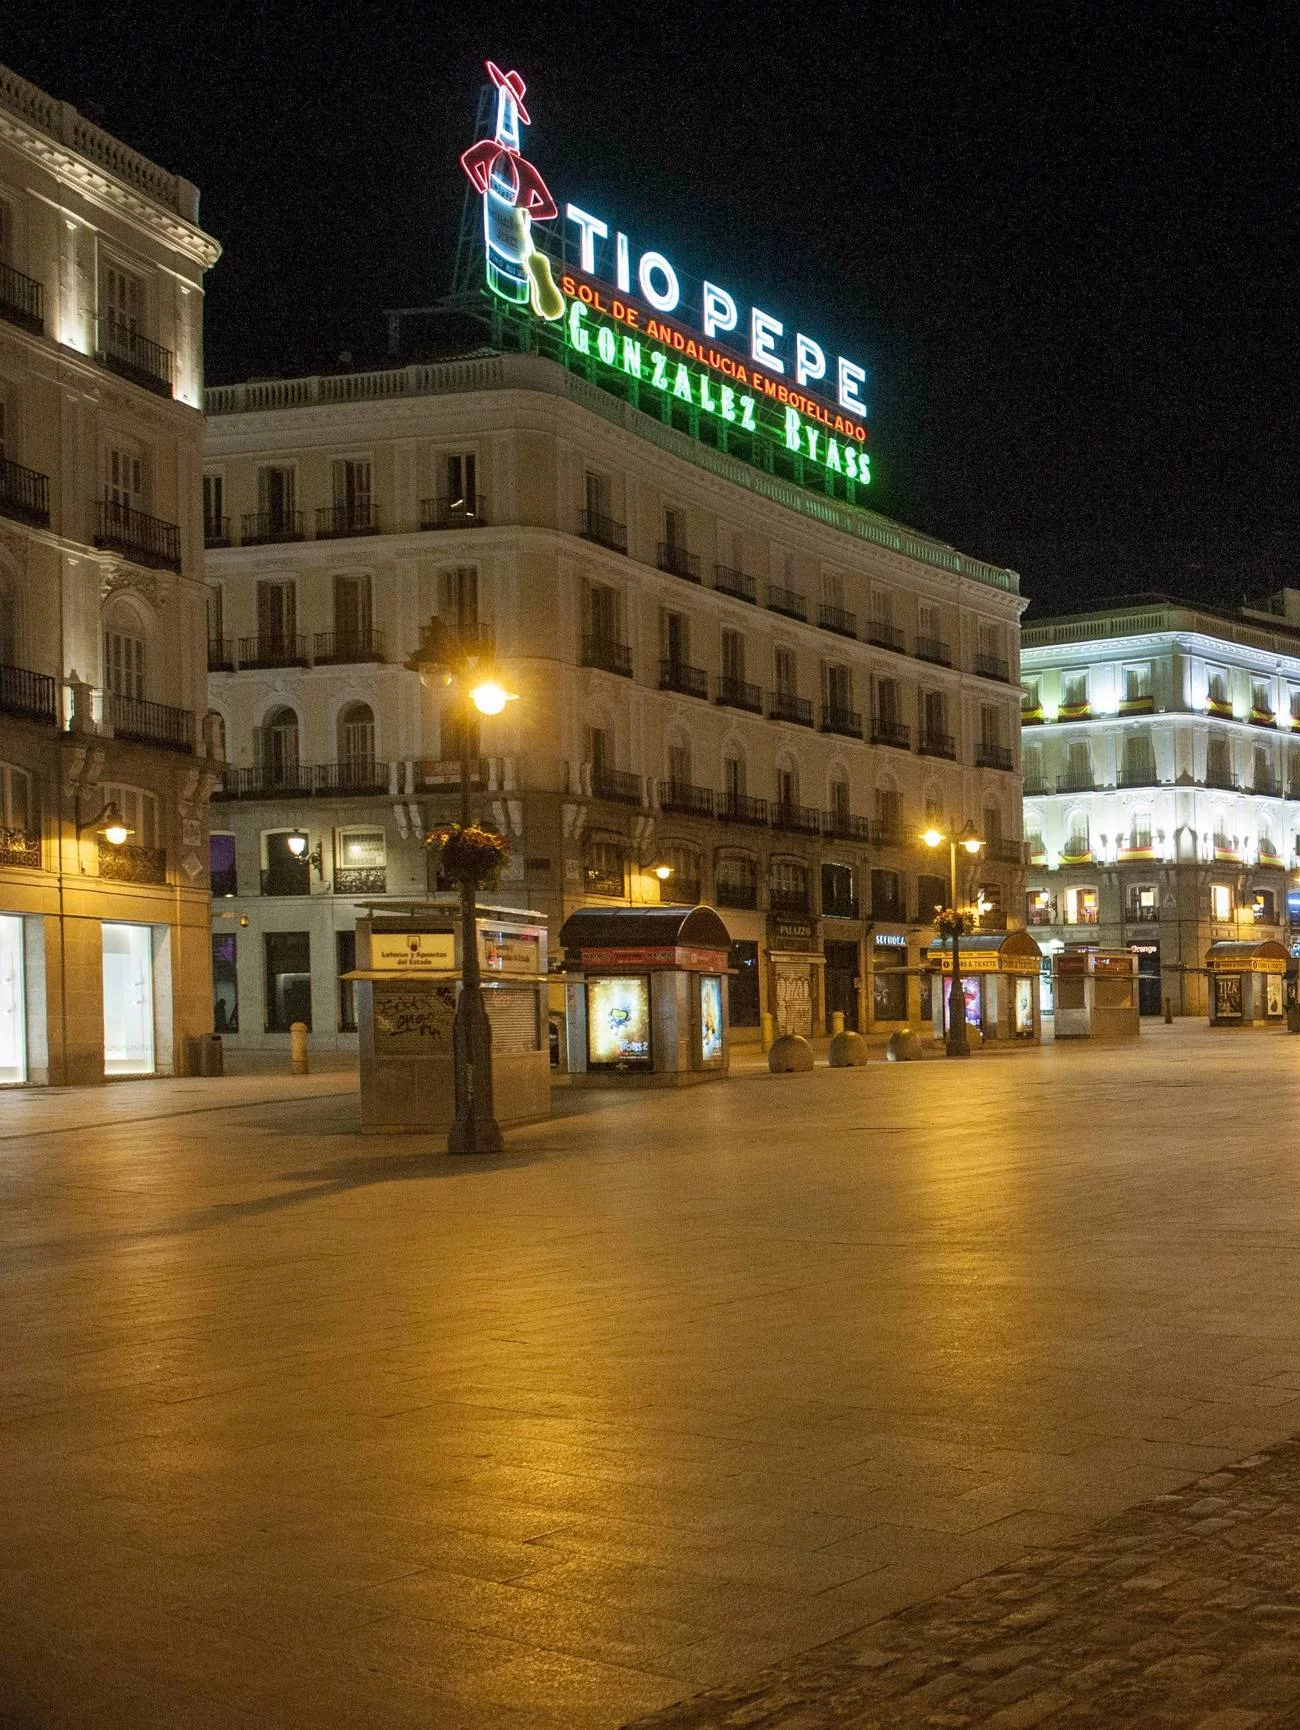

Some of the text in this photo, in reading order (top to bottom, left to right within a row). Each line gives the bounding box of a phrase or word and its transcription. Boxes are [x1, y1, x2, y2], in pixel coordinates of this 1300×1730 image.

[565, 202, 868, 418] TIO PEPE
[562, 276, 867, 444] SOL DE ANDALUCIA EMBOTELLADO
[567, 301, 871, 485] GONZALEZ BYASS
[780, 924, 811, 936] PALAZZO
[974, 960, 996, 968] TICKETS
[1131, 945, 1157, 954] Orange
